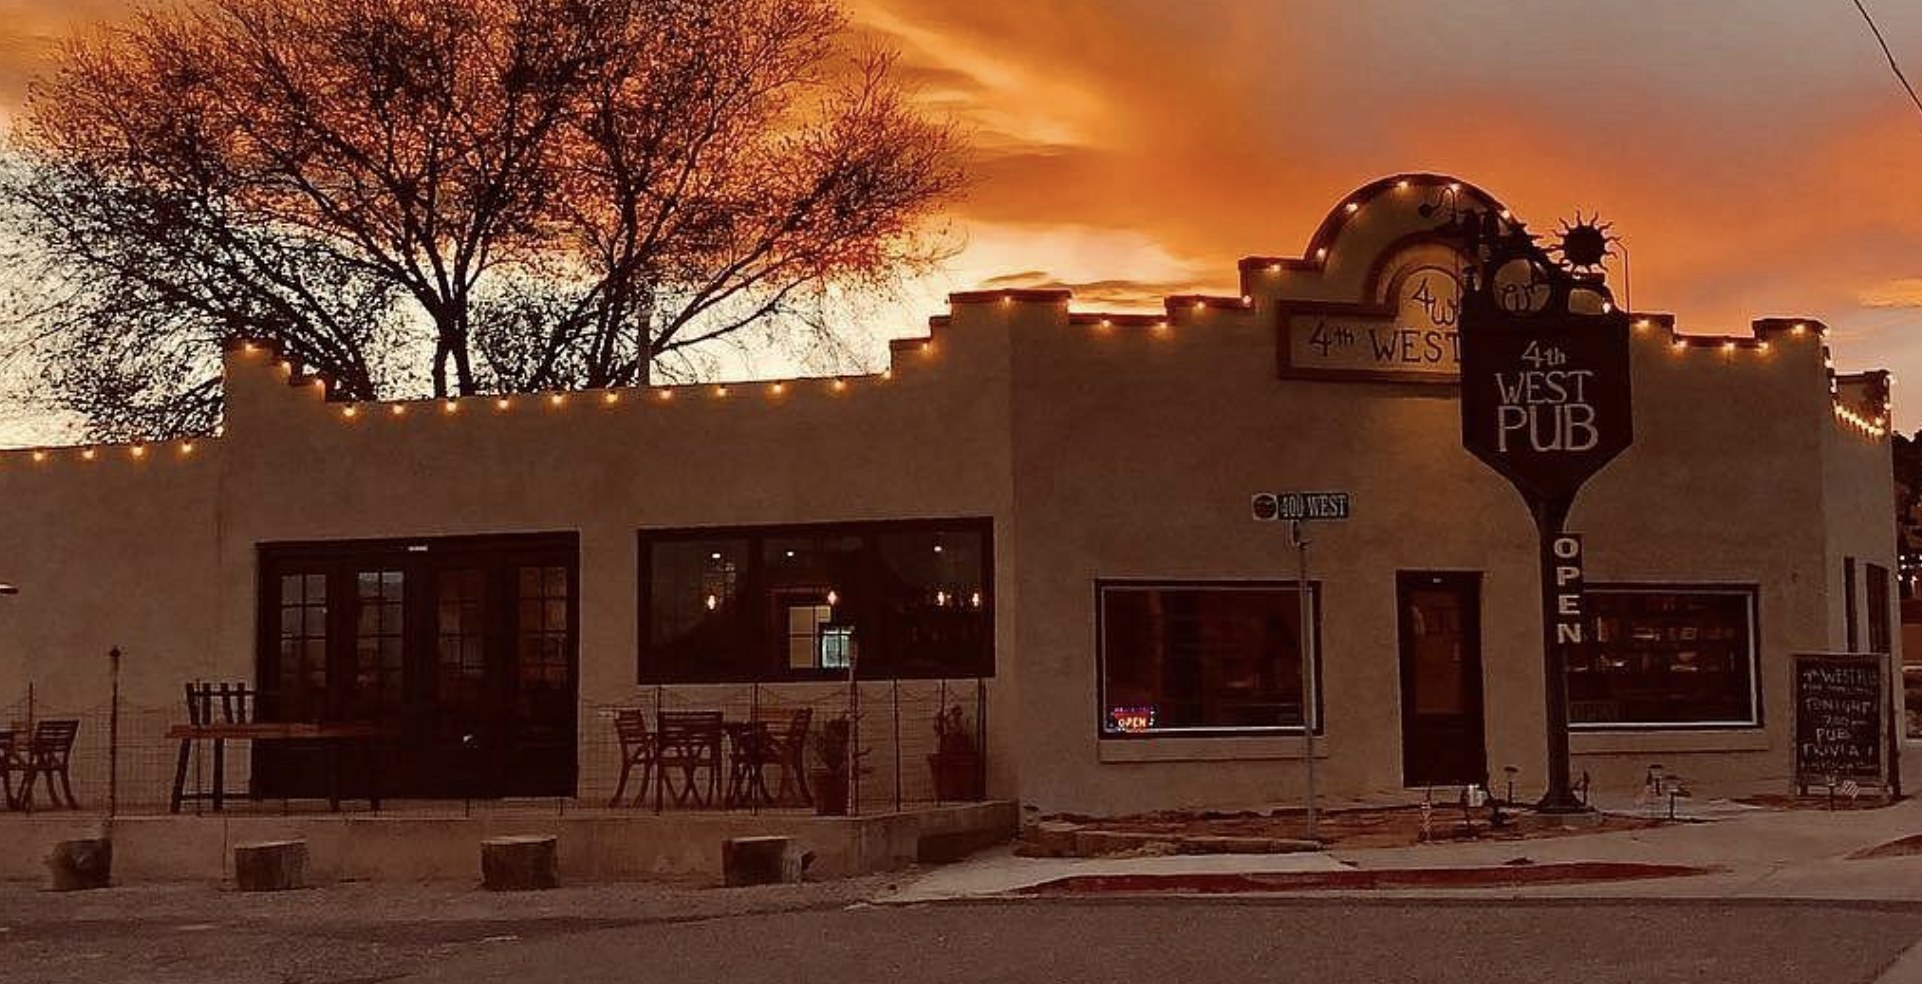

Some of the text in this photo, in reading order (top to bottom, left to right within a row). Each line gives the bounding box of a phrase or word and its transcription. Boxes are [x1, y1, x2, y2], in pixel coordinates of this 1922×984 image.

[1309, 320, 1462, 363] 4th WEST
[1520, 339, 1567, 369] 4th
[1494, 370, 1596, 406] WEST
[1495, 403, 1600, 453] PUB
[1308, 494, 1347, 517] WEST
[1552, 537, 1583, 645] OPEN
[1117, 716, 1147, 729] OPEN
